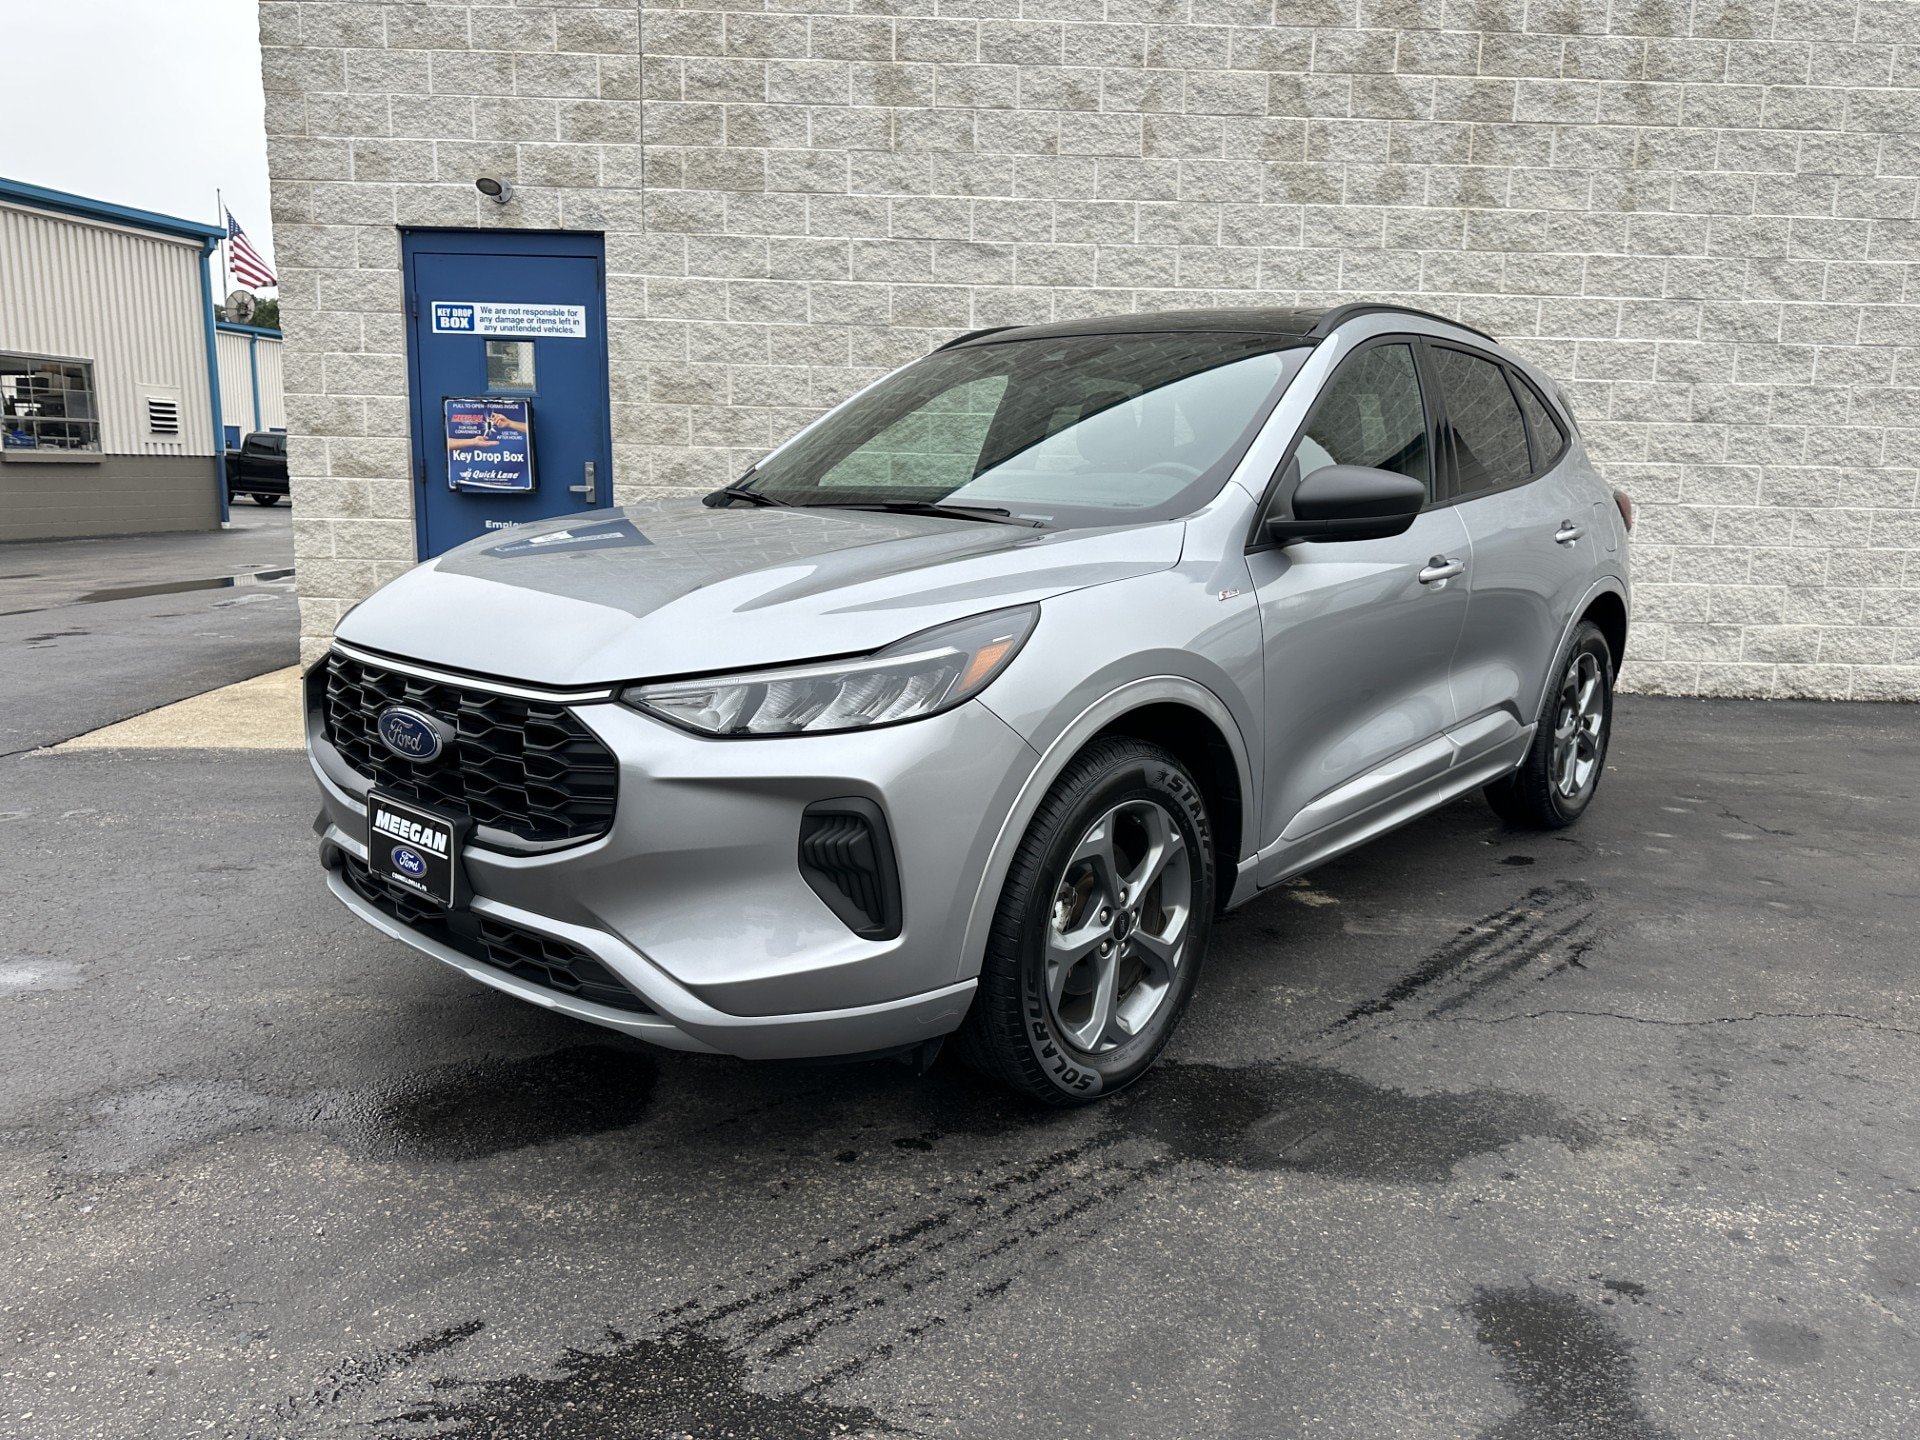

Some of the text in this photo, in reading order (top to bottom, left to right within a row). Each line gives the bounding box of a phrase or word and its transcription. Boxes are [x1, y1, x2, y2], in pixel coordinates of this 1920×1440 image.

[437, 308, 472, 317] KEY DROP
[480, 306, 493, 314] We
[508, 307, 521, 315] not
[522, 308, 566, 317] responsible
[440, 317, 470, 329] BOX
[479, 317, 493, 325] any
[495, 316, 525, 325] damage
[536, 317, 557, 325] items
[484, 324, 576, 334] any unattended vehicles.
[453, 450, 525, 464] Key Drop Box
[472, 470, 519, 479] Quick Lane
[485, 520, 522, 529] Emplo
[387, 717, 422, 751] Ford
[374, 808, 448, 853] MEEGAN
[399, 851, 420, 872] Ford
